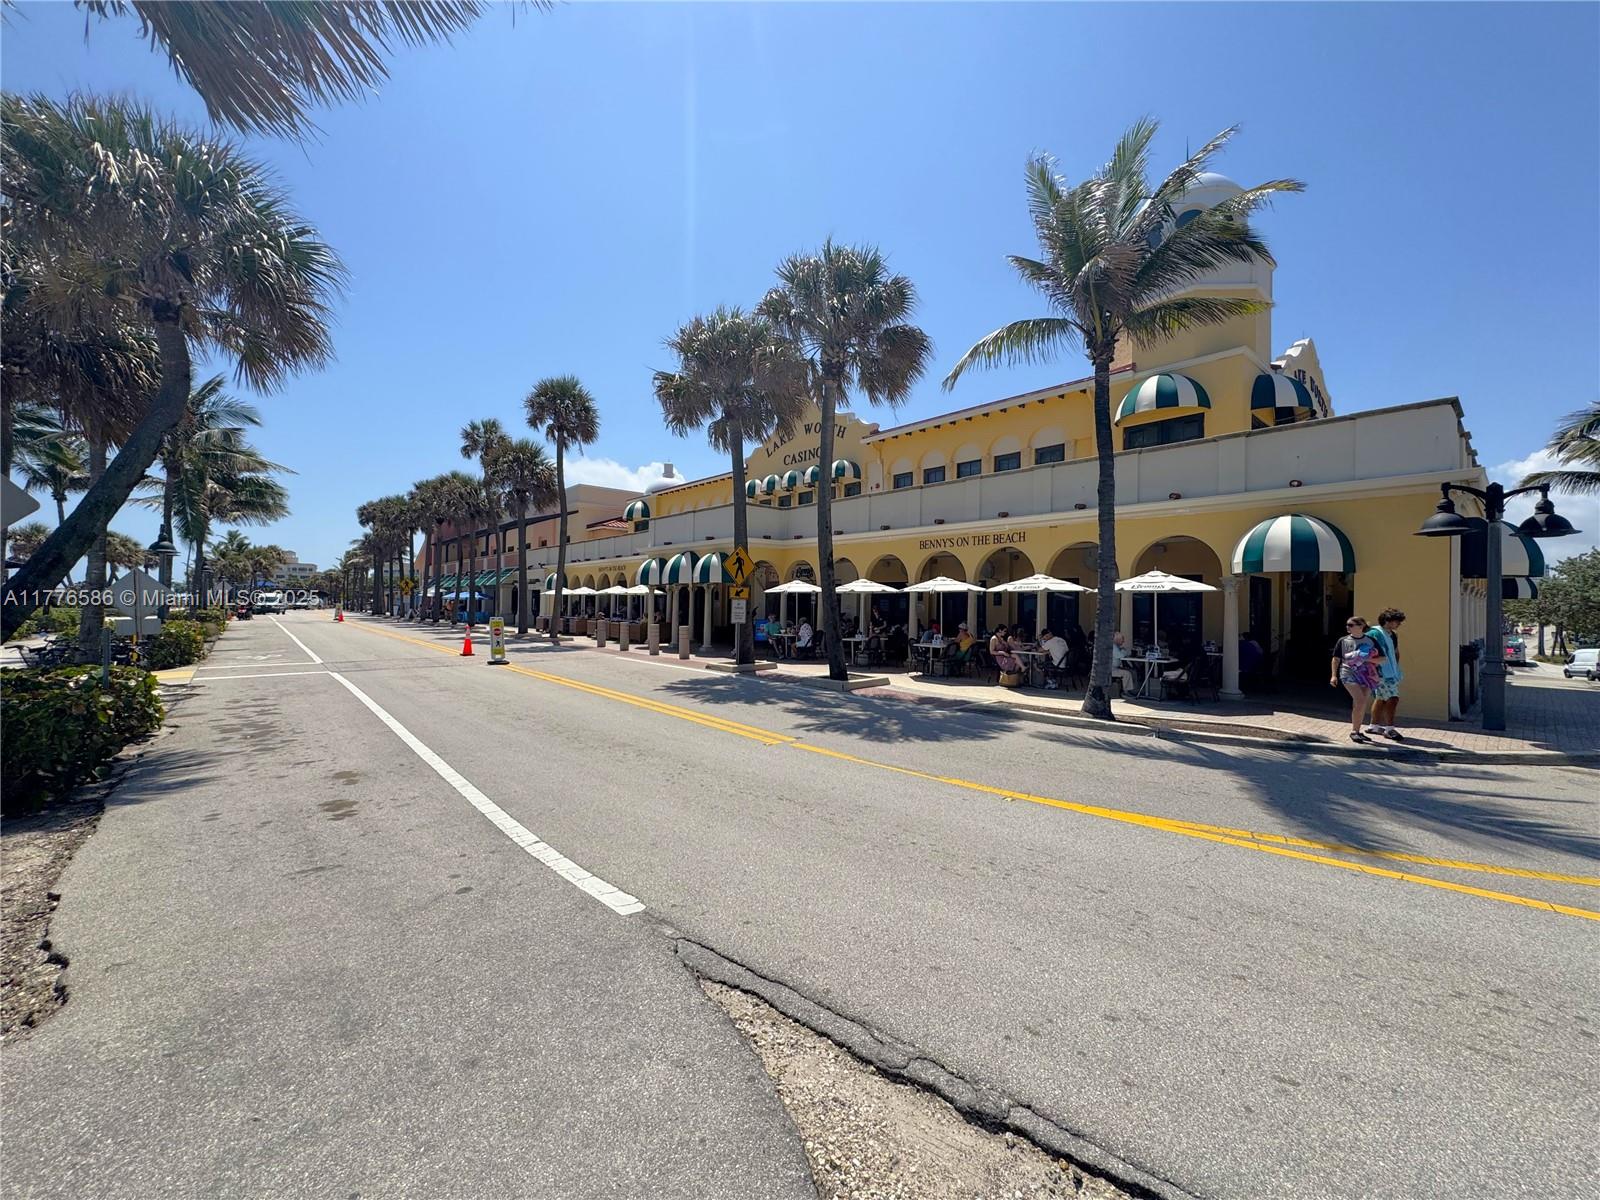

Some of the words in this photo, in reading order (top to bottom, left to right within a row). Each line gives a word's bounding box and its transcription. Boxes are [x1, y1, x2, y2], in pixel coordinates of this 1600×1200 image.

[765, 430, 795, 458] LAKE
[919, 538, 955, 550] BENNY'S
[956, 536, 970, 547] ON
[971, 535, 991, 546] THE
[993, 531, 1026, 545] BEACH
